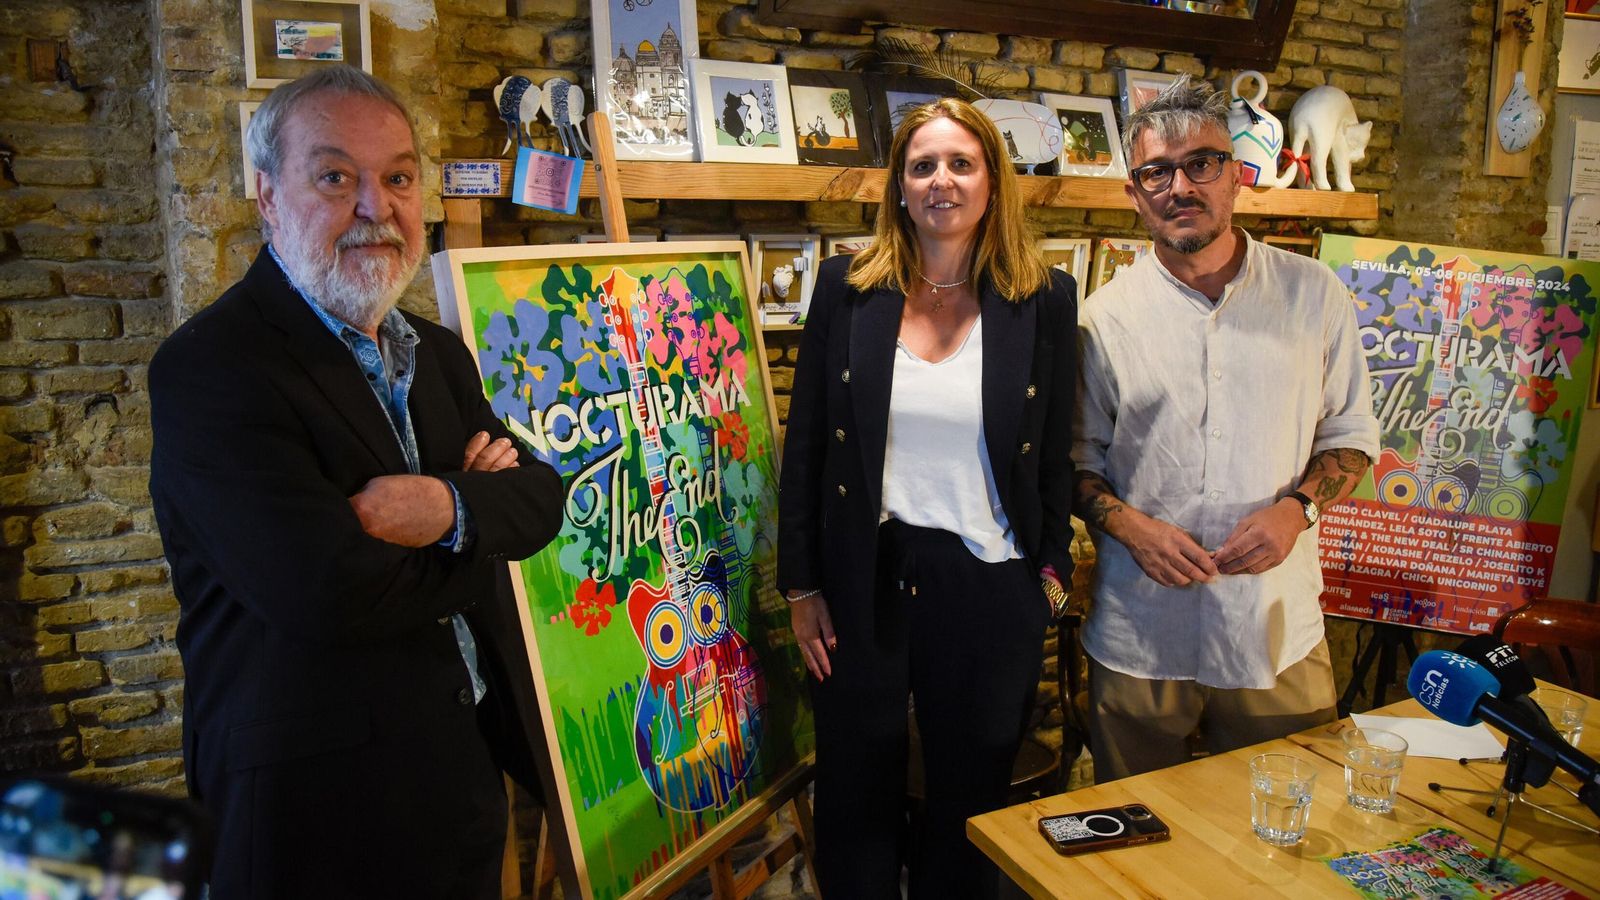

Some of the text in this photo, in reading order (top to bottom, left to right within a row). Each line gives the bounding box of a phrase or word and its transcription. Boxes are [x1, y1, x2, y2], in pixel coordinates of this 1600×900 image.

[1352, 260, 1571, 292] SEVILLA, 05-08 DICIEMBRE 2024
[1358, 326, 1573, 380] OCTURAMA
[1420, 384, 1515, 461] End
[565, 431, 740, 584] The End
[1328, 504, 1512, 537] UIDO CLAVEL / GUADALUPE PLATA
[1321, 514, 1553, 554] FERNÁNDEZ, LELA SOTO Y FRENTE ABIERTO
[1323, 527, 1533, 563] CHUFA & THE NEW DEAL / SR CHINARRO
[1318, 536, 1545, 576] GUZMÁN / KORASHE / REZELO / JOSELITO K
[1327, 550, 1356, 562] ARCO
[1359, 553, 1365, 563] /
[1366, 555, 1407, 569] SALVAR
[1410, 561, 1456, 576] DOÑANA
[1459, 567, 1465, 577] /
[1466, 569, 1514, 584] MARIETA
[1349, 564, 1391, 578] AZAGRA
[1394, 570, 1400, 579] /
[1402, 572, 1434, 584] CHICA
[1437, 577, 1497, 593] UNICORNIO
[1431, 677, 1450, 710] Noticias
